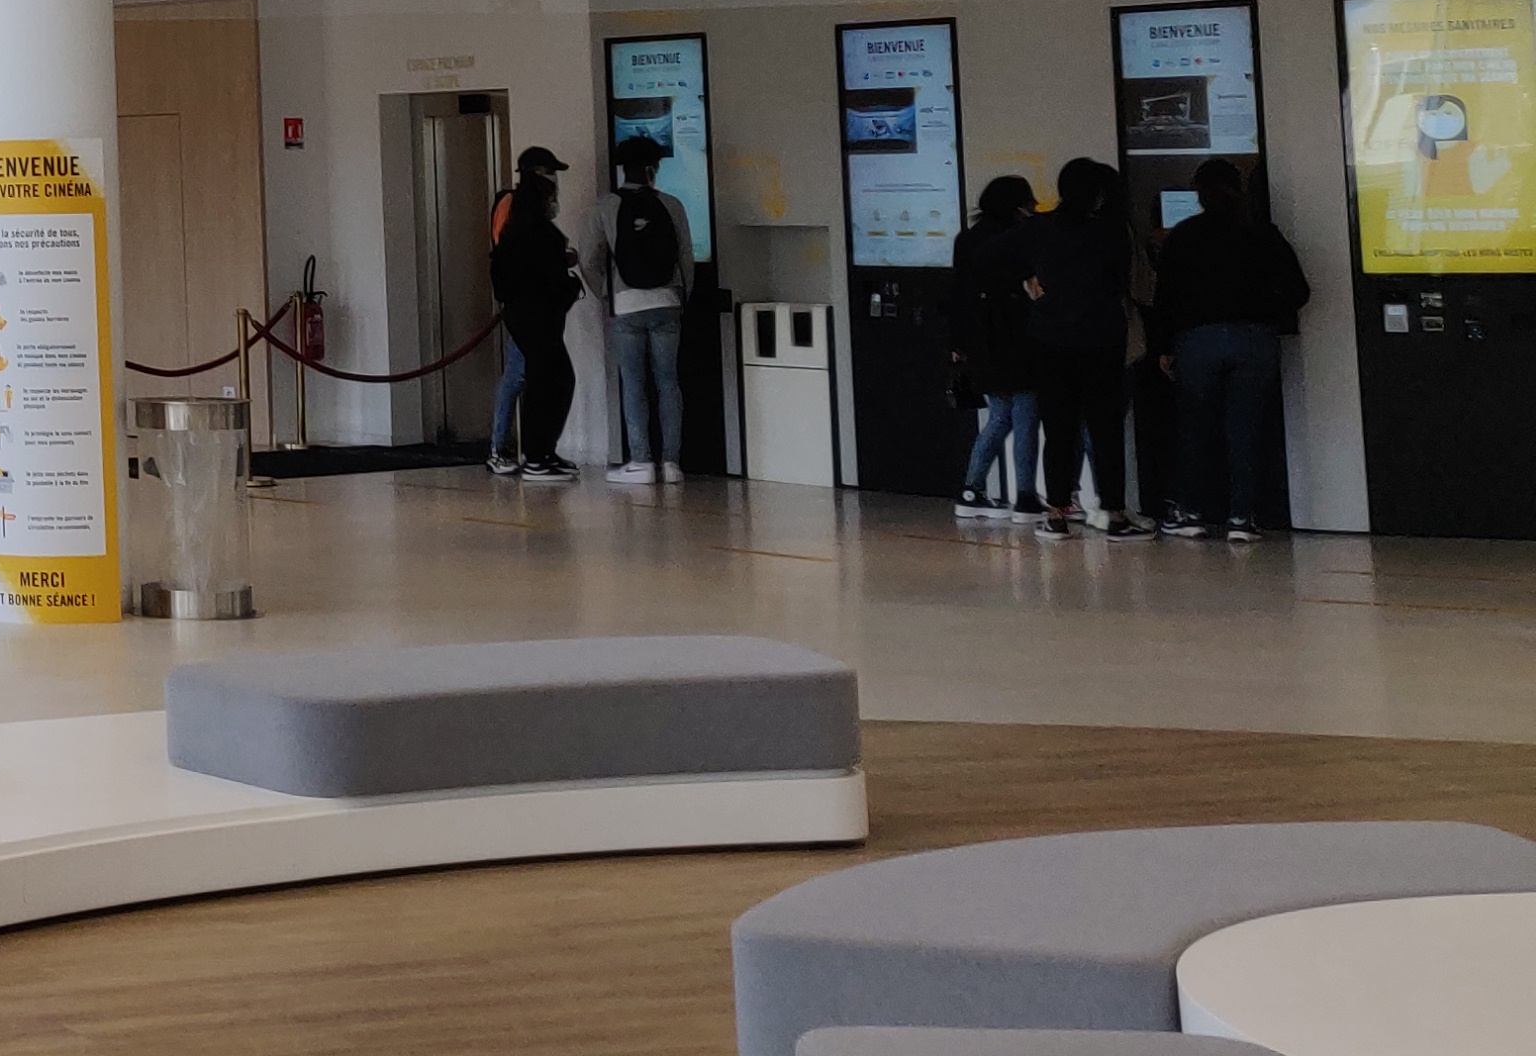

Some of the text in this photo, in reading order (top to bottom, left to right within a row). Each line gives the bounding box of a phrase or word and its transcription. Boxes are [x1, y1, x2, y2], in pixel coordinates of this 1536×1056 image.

[1149, 23, 1221, 40] BIENVENUE
[867, 39, 925, 55] BIENVENUE
[631, 52, 682, 67] BIENVENUE
[0, 184, 40, 199] VOTRE
[44, 180, 93, 198] CINÉMA
[1, 228, 9, 238] la
[10, 227, 46, 239] sécurité
[47, 228, 58, 238] de
[59, 228, 80, 239] tous,
[31, 238, 81, 250] précautions
[19, 571, 66, 588] MERCI
[8, 593, 42, 607] BONNE
[46, 591, 88, 607] SÉANCE
